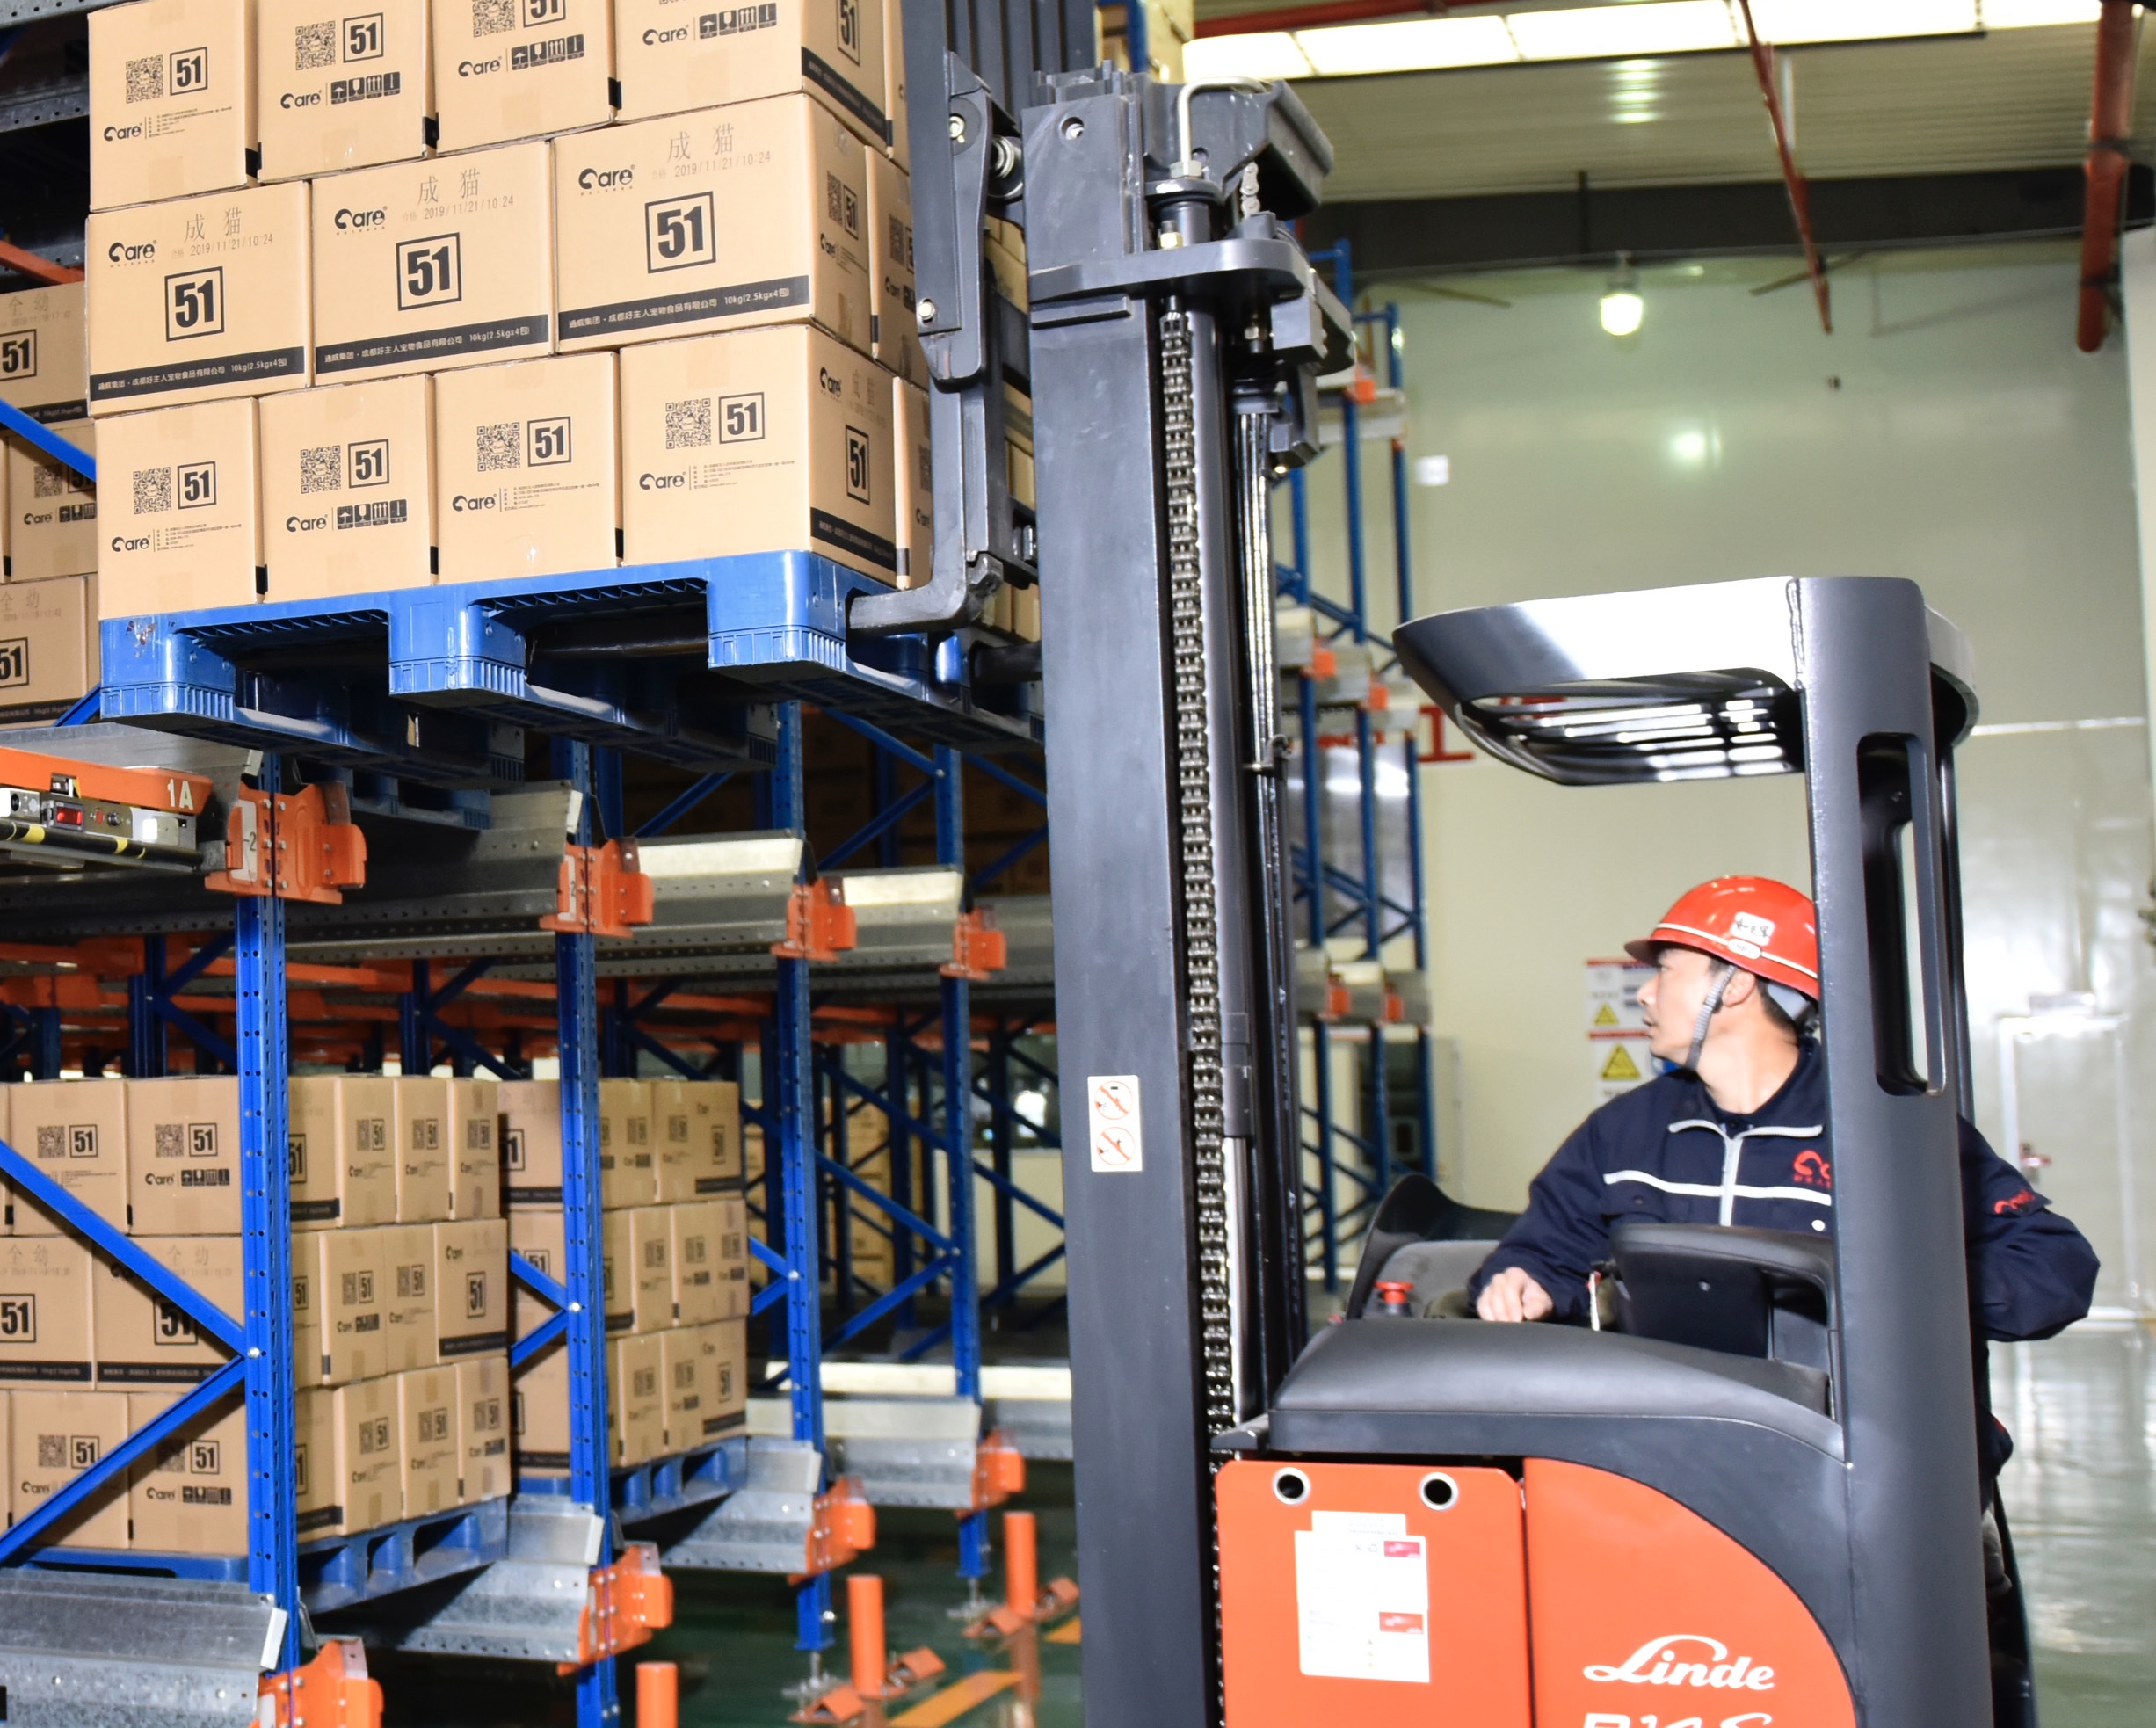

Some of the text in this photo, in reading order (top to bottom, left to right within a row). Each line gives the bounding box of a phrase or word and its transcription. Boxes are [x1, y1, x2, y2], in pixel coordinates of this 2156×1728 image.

[840, 0, 856, 50] 51
[350, 22, 377, 54] 51
[642, 28, 688, 46] Care
[177, 55, 201, 87] 51
[458, 59, 500, 76] Care
[280, 92, 321, 109] Care
[104, 125, 142, 142] Care
[578, 168, 633, 190] Care
[334, 208, 385, 229] Care
[657, 205, 703, 258] 51
[109, 242, 156, 263] Care
[407, 245, 450, 296] 51
[175, 279, 214, 328] 51
[2, 338, 30, 373] 51
[727, 402, 757, 435] 51
[535, 425, 563, 458] 51
[355, 448, 382, 480] 51
[849, 438, 867, 490] 51
[184, 470, 209, 501] 51
[639, 473, 685, 490] Care
[453, 495, 495, 512] Care
[24, 513, 52, 525] Care
[287, 516, 327, 532] Care
[112, 537, 149, 552] Care
[0, 646, 22, 680] 51
[74, 1130, 93, 1153] 51
[193, 1129, 213, 1151] 51
[145, 1173, 175, 1186] Care
[295, 1283, 306, 1304] 51
[361, 1277, 371, 1298] 51
[470, 1281, 483, 1310] 51
[1, 1302, 29, 1334] 51
[76, 1442, 96, 1463] 51
[195, 1447, 214, 1468] 51
[1583, 1634, 1775, 1690] Linde
